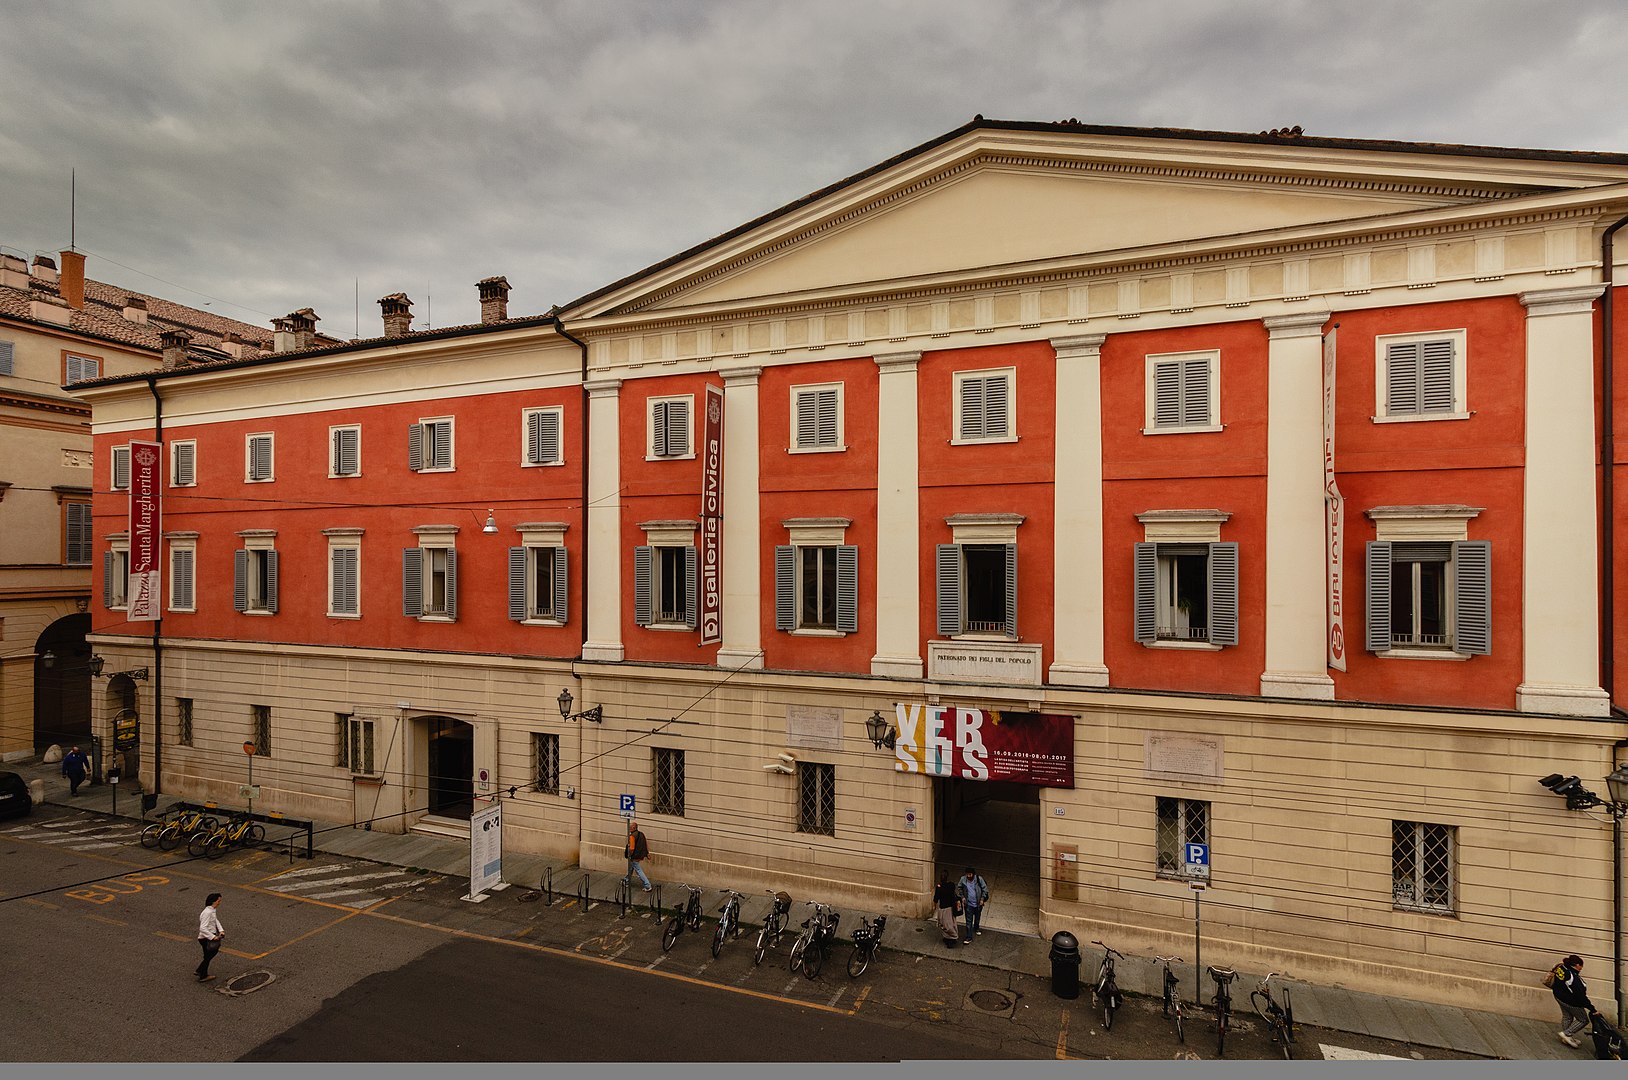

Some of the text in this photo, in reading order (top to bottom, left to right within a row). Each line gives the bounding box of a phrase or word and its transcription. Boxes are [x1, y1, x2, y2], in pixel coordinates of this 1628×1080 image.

[134, 467, 156, 618] Palazzo Santa Margherita
[704, 439, 719, 608] galleria civica
[64, 873, 170, 905] BUS
